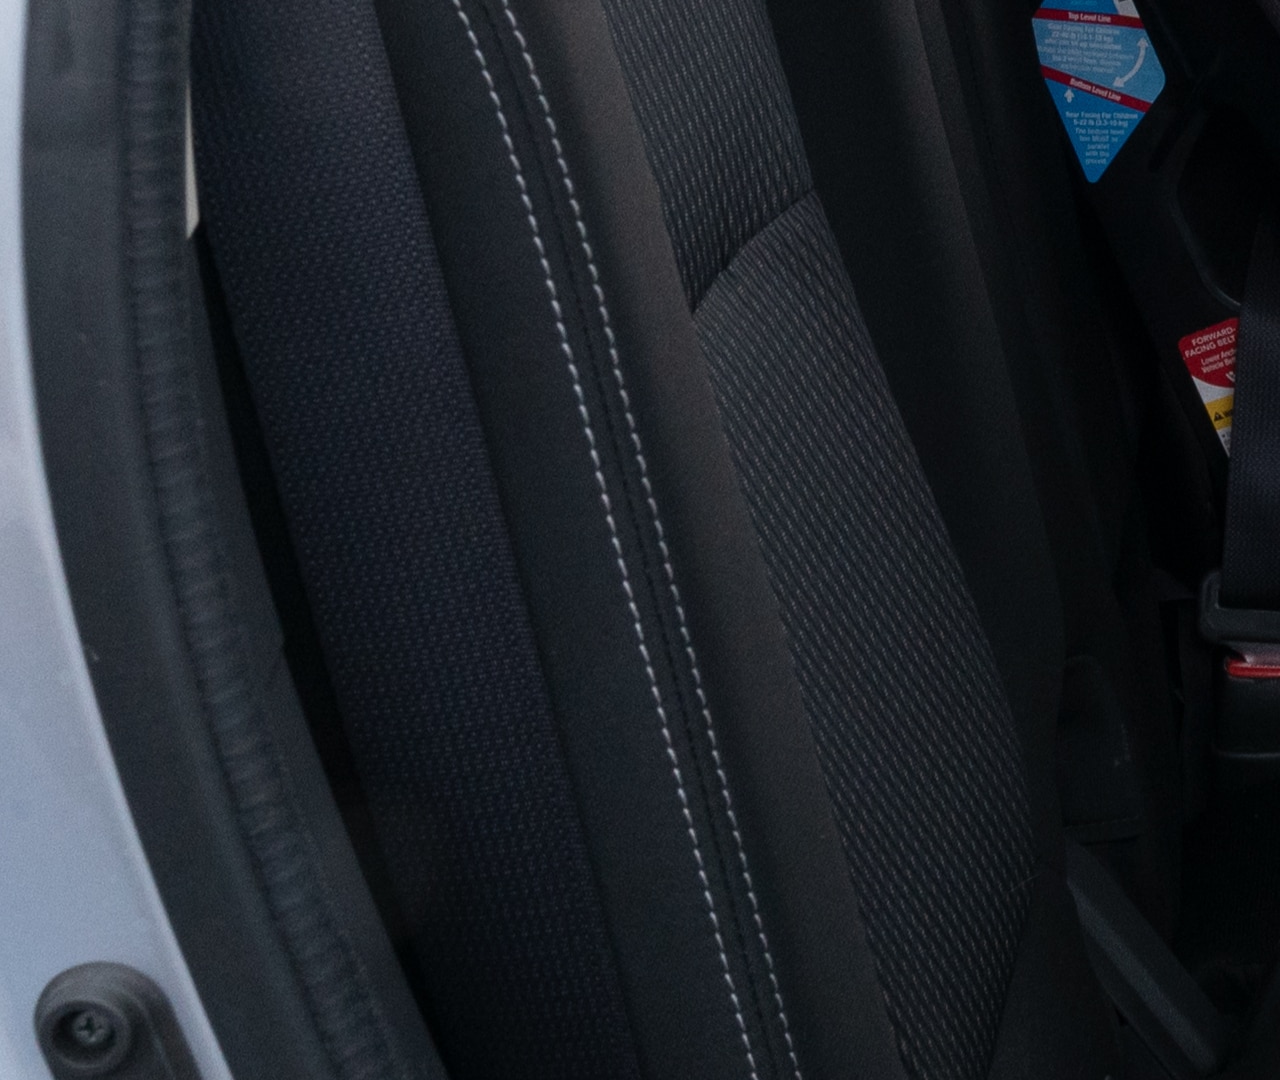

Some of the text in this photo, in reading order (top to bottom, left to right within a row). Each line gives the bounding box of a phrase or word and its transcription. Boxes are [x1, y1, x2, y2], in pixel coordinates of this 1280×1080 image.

[1068, 12, 1111, 23] Top Level Line
[1092, 84, 1108, 97] Level
[1108, 90, 1121, 101] Line
[1192, 326, 1236, 346] FORWARD-
[1184, 334, 1236, 358] FACING BELT
